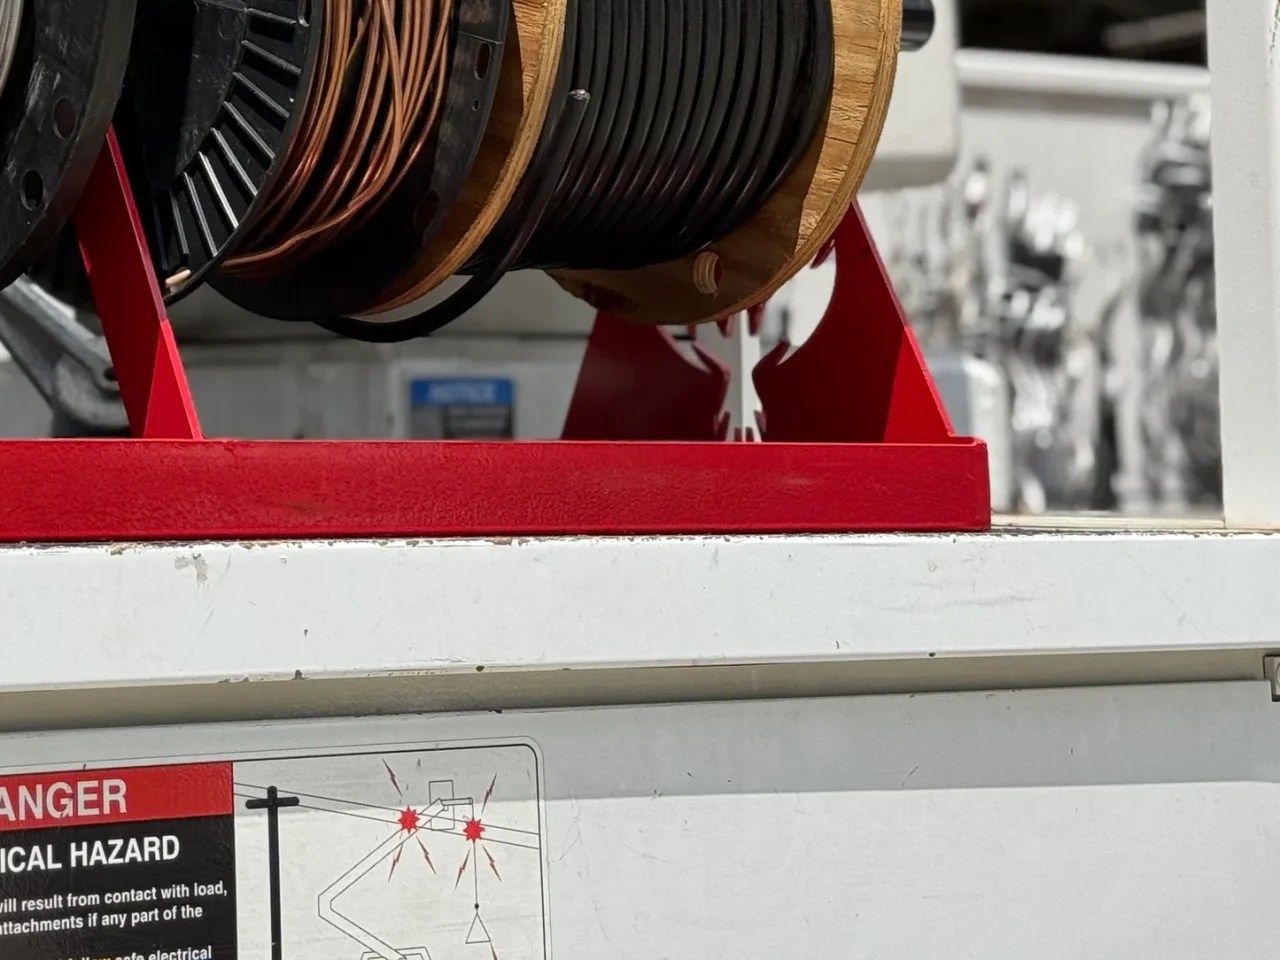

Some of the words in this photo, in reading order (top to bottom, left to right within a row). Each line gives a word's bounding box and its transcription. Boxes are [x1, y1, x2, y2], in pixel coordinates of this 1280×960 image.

[70, 835, 180, 868] HAZARD
[21, 894, 63, 912] result
[67, 893, 100, 907] from
[104, 887, 157, 904] contact
[161, 884, 190, 899] with
[194, 880, 228, 897] load,
[88, 912, 98, 927] if
[102, 913, 127, 928] any
[131, 908, 160, 926] part
[163, 906, 178, 921] of
[181, 904, 203, 919] the
[148, 945, 212, 960] electrical
